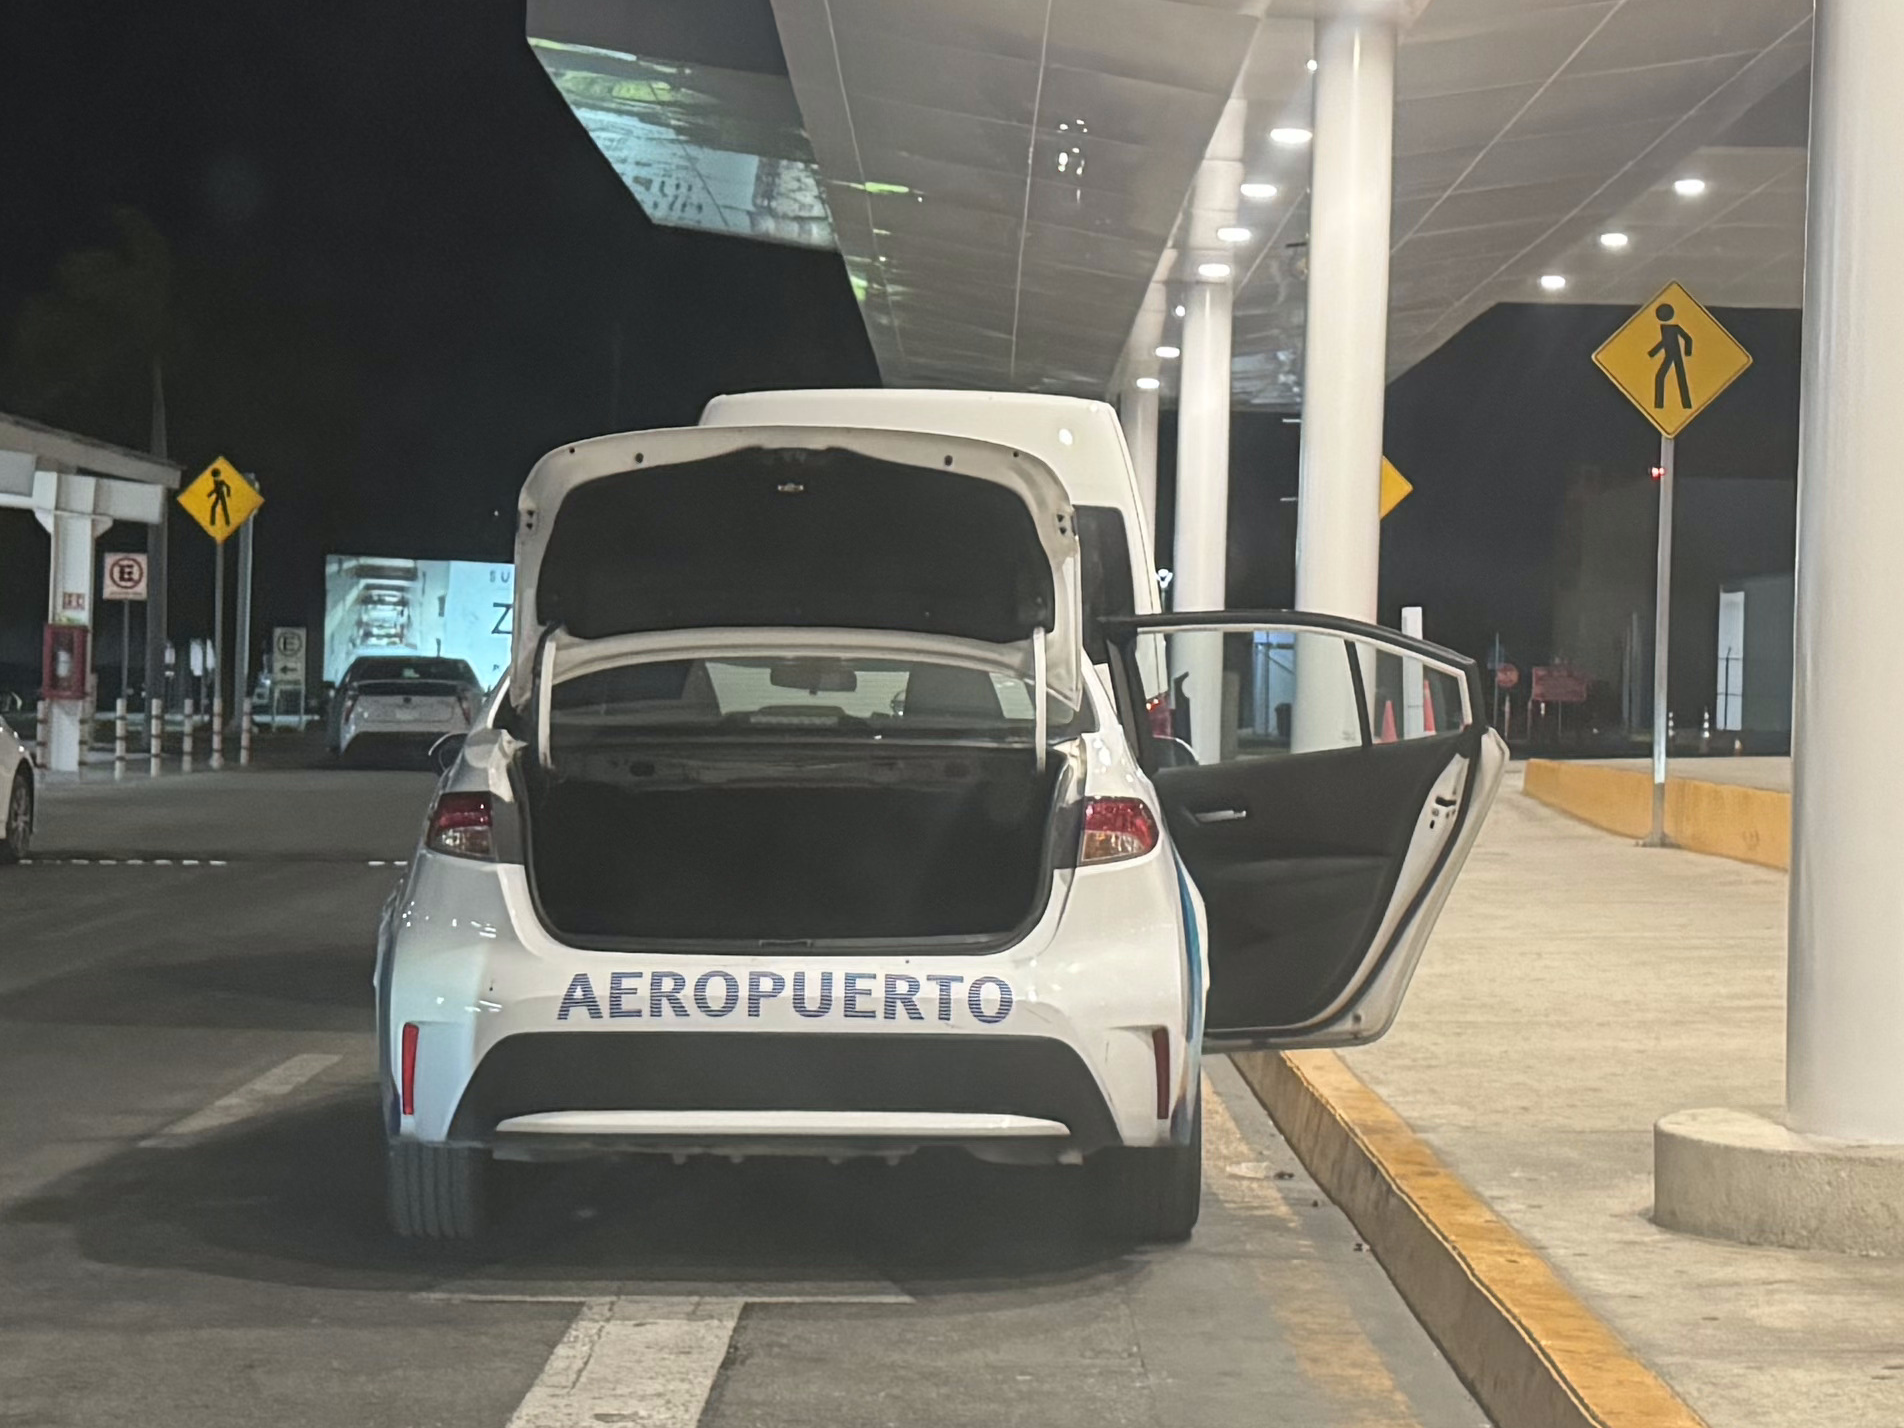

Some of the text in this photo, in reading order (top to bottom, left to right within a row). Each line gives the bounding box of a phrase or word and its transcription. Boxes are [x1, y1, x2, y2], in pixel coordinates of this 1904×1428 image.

[119, 564, 135, 582] E
[491, 602, 514, 634] Z
[557, 969, 1014, 1024] AEROPUERTO
